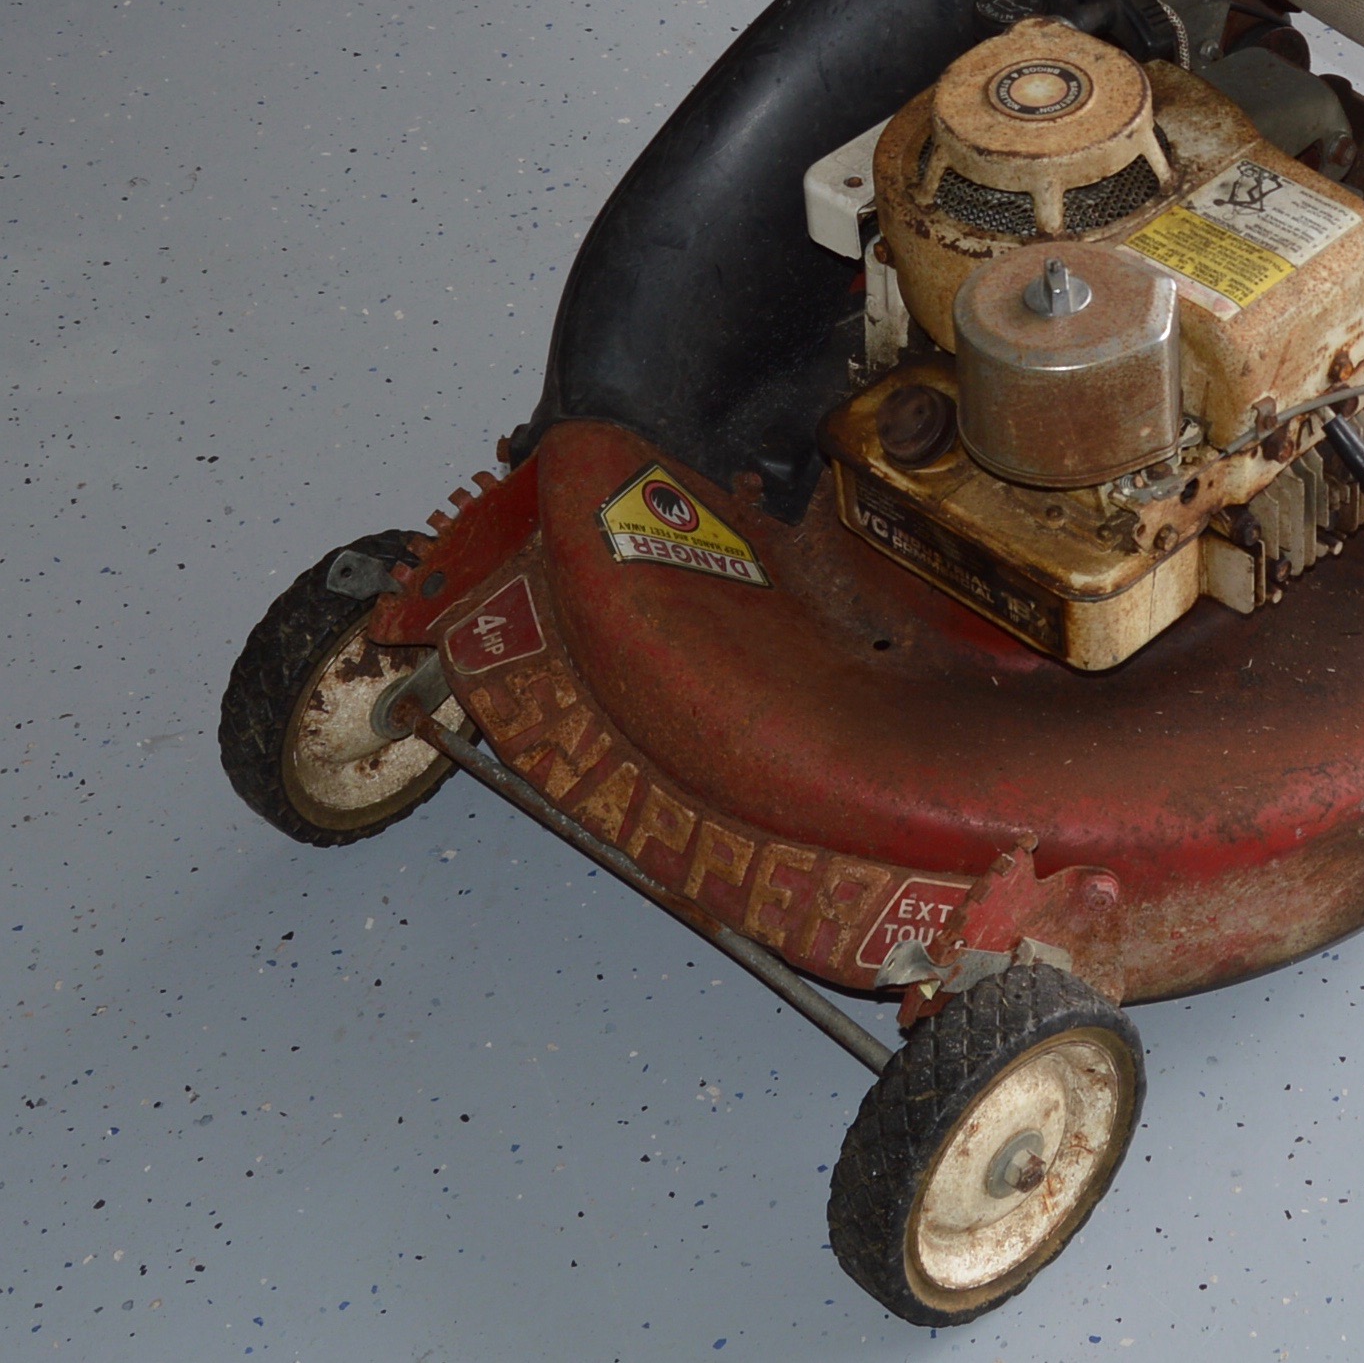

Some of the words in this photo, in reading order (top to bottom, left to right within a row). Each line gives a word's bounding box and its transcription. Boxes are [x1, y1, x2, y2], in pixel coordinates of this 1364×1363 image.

[1022, 66, 1061, 75] BRIGGS
[999, 79, 1021, 111] STRATTON
[619, 521, 646, 532] AWAY
[650, 528, 671, 538] FEET
[692, 537, 721, 551] HANDS
[724, 545, 745, 557] KEEP
[629, 535, 752, 578] DANGER
[469, 660, 891, 969] SNAPPER
[898, 899, 953, 923] EXT
